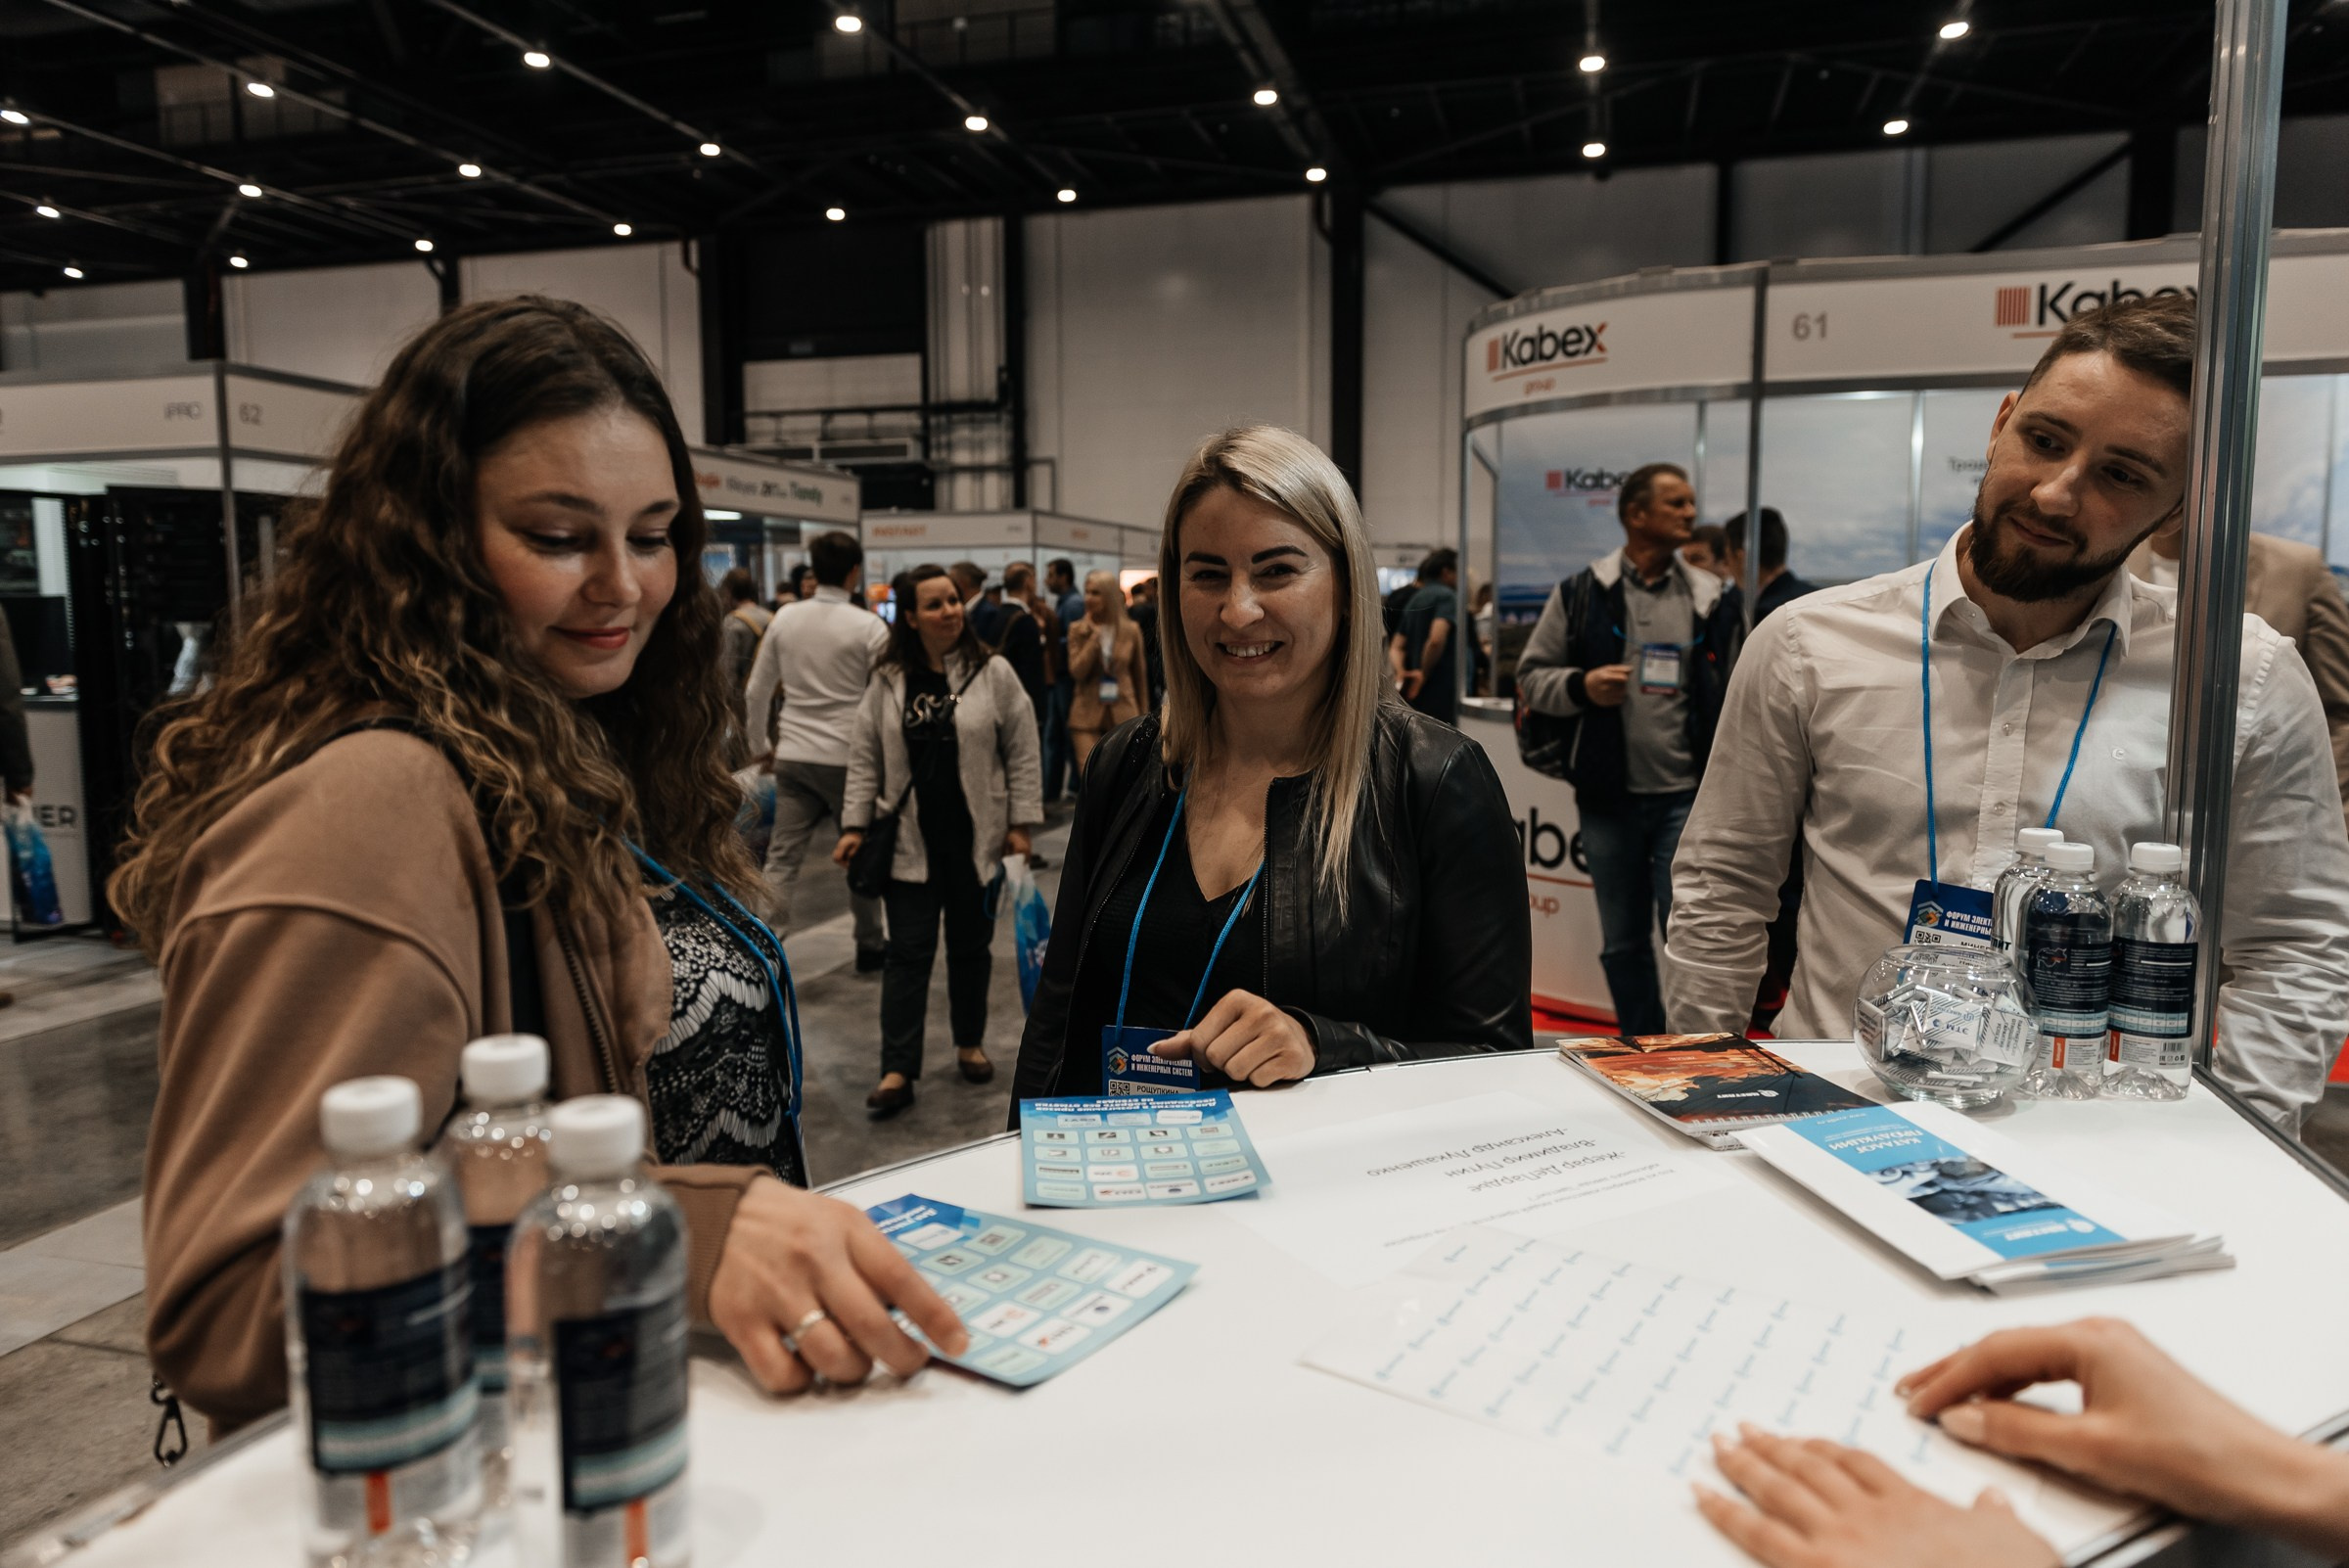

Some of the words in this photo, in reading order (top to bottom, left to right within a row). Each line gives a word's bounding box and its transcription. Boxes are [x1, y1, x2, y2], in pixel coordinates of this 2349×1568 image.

[1793, 312, 1827, 341] 61
[1500, 322, 1607, 370] Kabex
[239, 401, 262, 425] 62
[1565, 467, 1630, 490] Kabe
[1946, 910, 1971, 922] ФОРУМ
[1130, 1054, 1151, 1063] ФОРУМ
[1136, 1063, 1172, 1075] ИНЖЕНЕРНЫХ
[1172, 1067, 1193, 1077] СИСТЕМ
[1828, 1130, 1924, 1151] ПРОДУКЦИИ
[1856, 1137, 1922, 1154] КАТАЛОГ
[1367, 1149, 1471, 1176] Лукашенко
[1445, 1161, 1504, 1177] Путин
